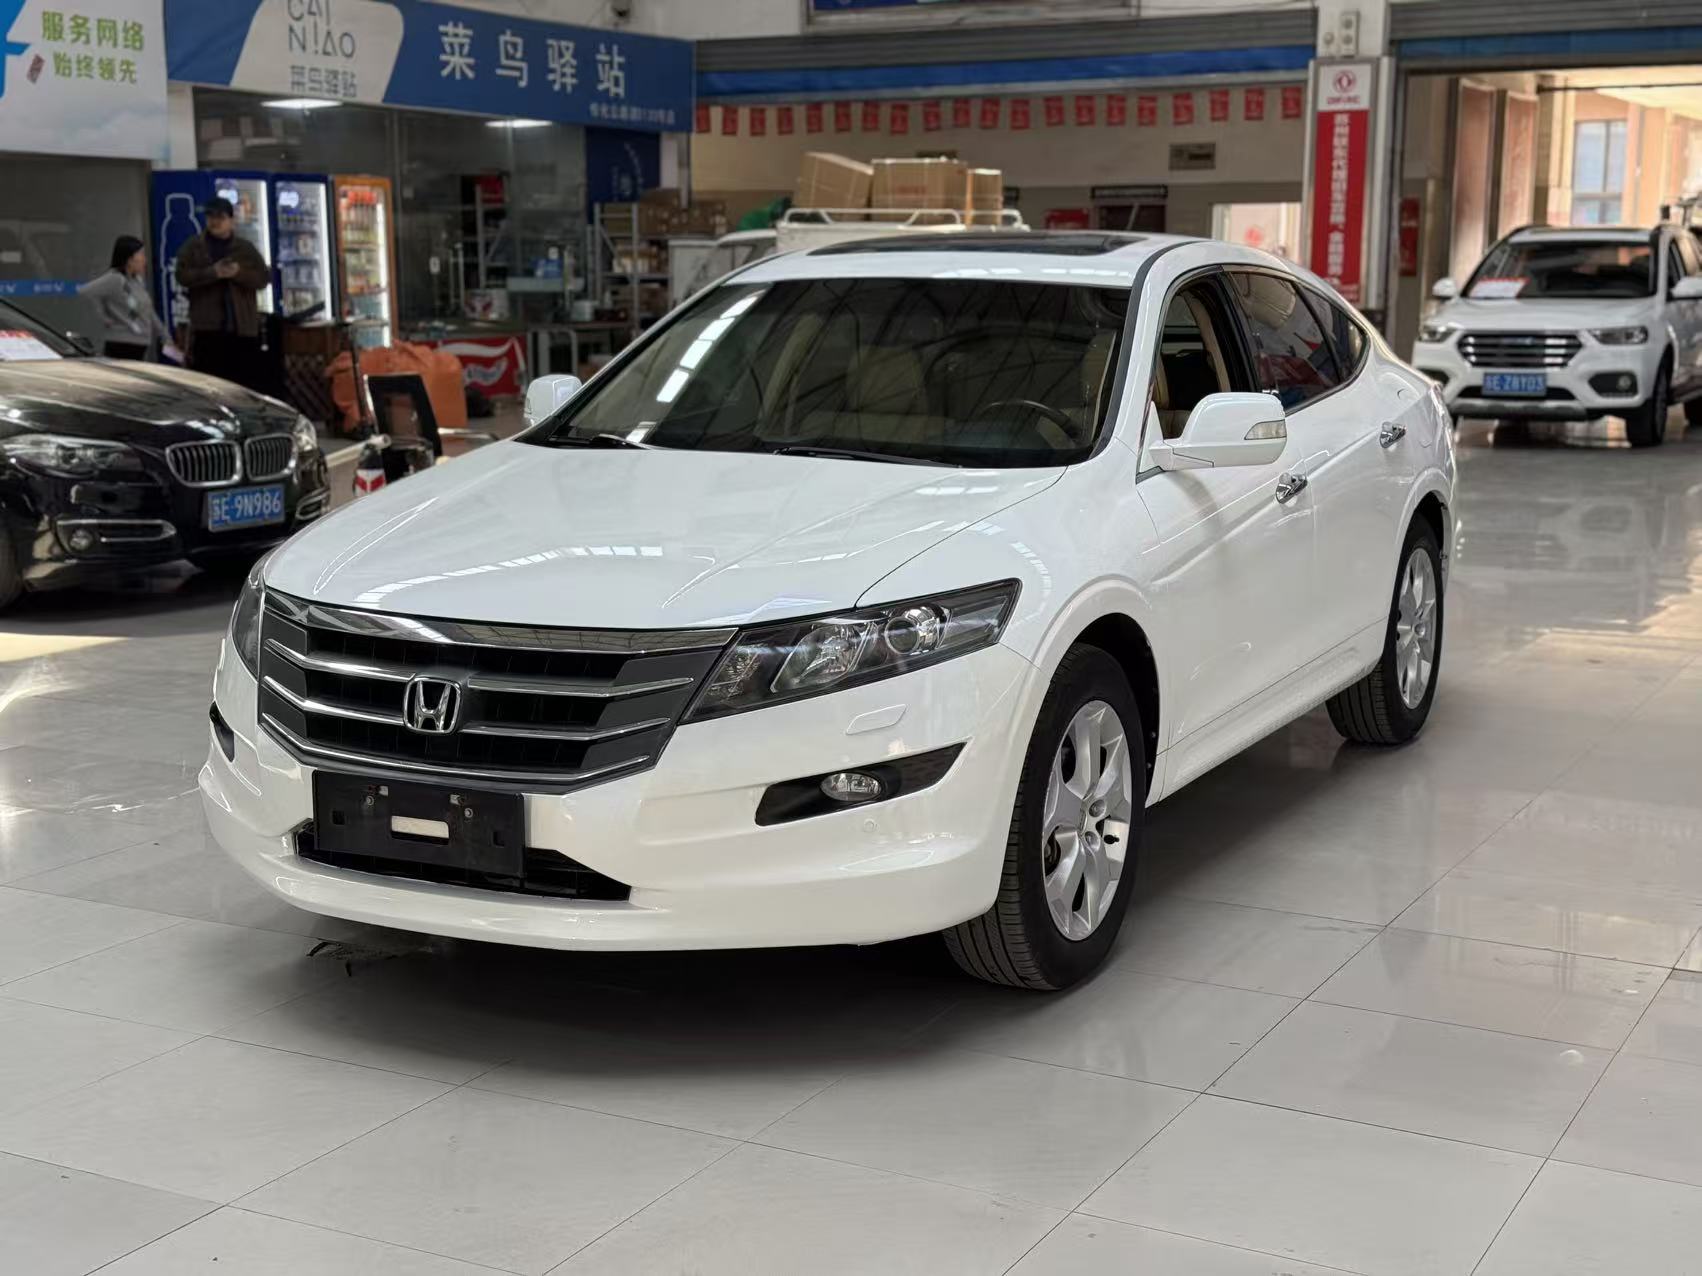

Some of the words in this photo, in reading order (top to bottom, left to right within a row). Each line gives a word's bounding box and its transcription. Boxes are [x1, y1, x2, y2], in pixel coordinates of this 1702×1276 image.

[41, 10, 145, 52] 服务网络
[53, 51, 138, 85] 始终领先
[438, 20, 627, 99] 菜鸟驿站
[290, 64, 358, 98] 菜鸟驿站
